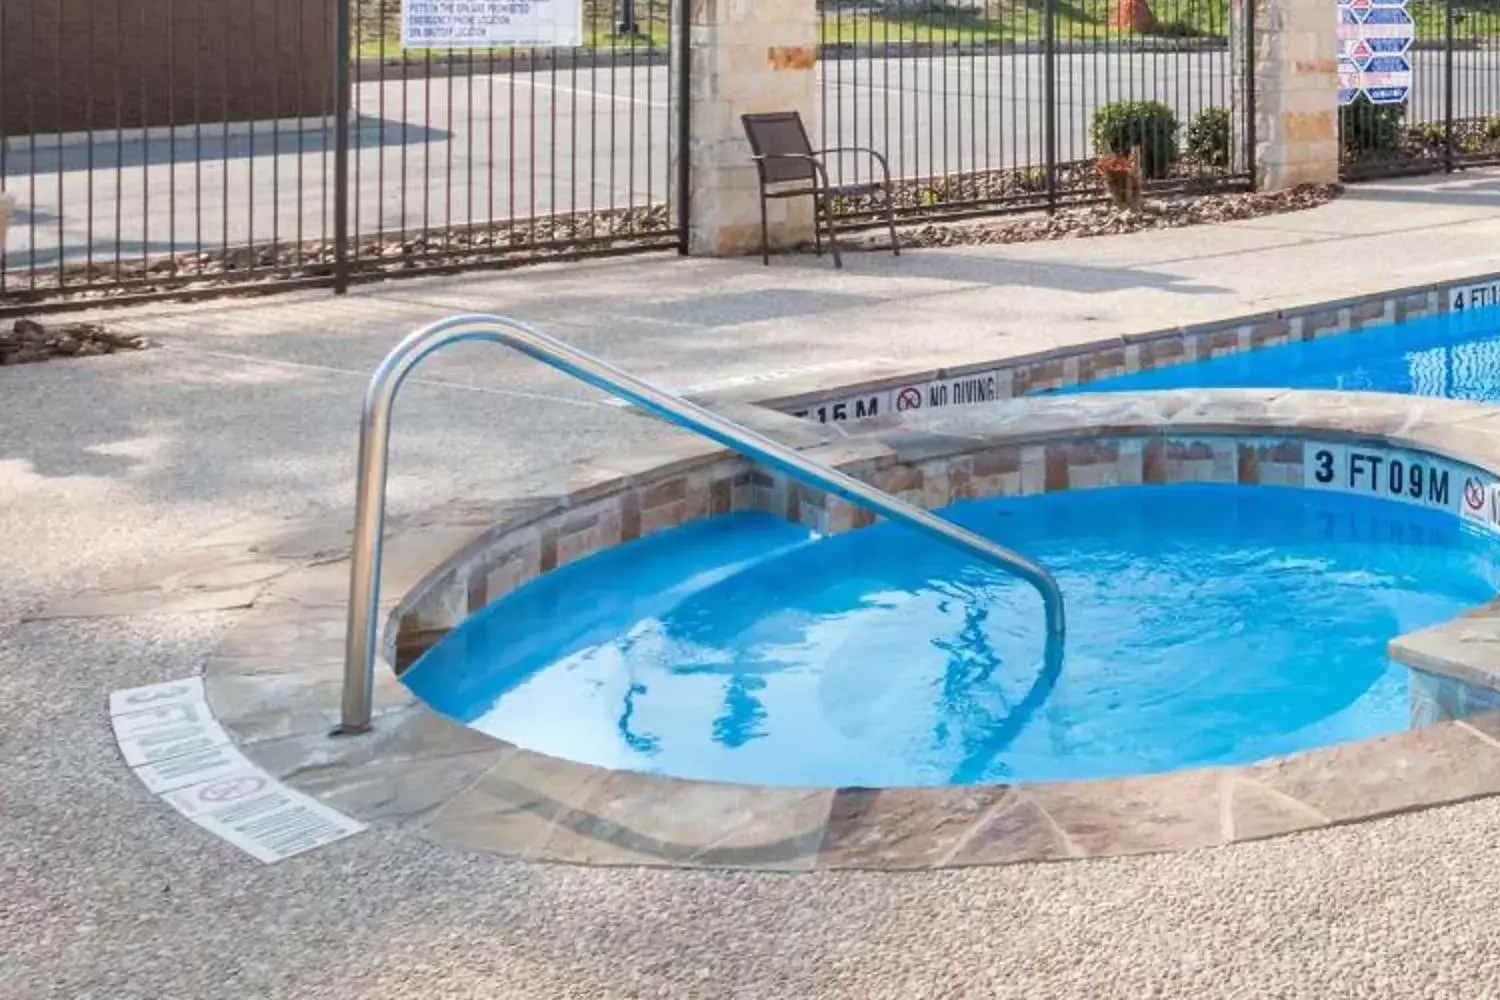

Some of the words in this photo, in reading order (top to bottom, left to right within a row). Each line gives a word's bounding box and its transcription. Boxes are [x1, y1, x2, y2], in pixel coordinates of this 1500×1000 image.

[1454, 291, 1464, 312] 4
[1471, 287, 1487, 309] FT
[929, 384, 947, 407] NO
[953, 376, 995, 405] DIVING
[1314, 450, 1335, 484] 3
[1350, 453, 1384, 491] FT
[1429, 467, 1449, 505] M
